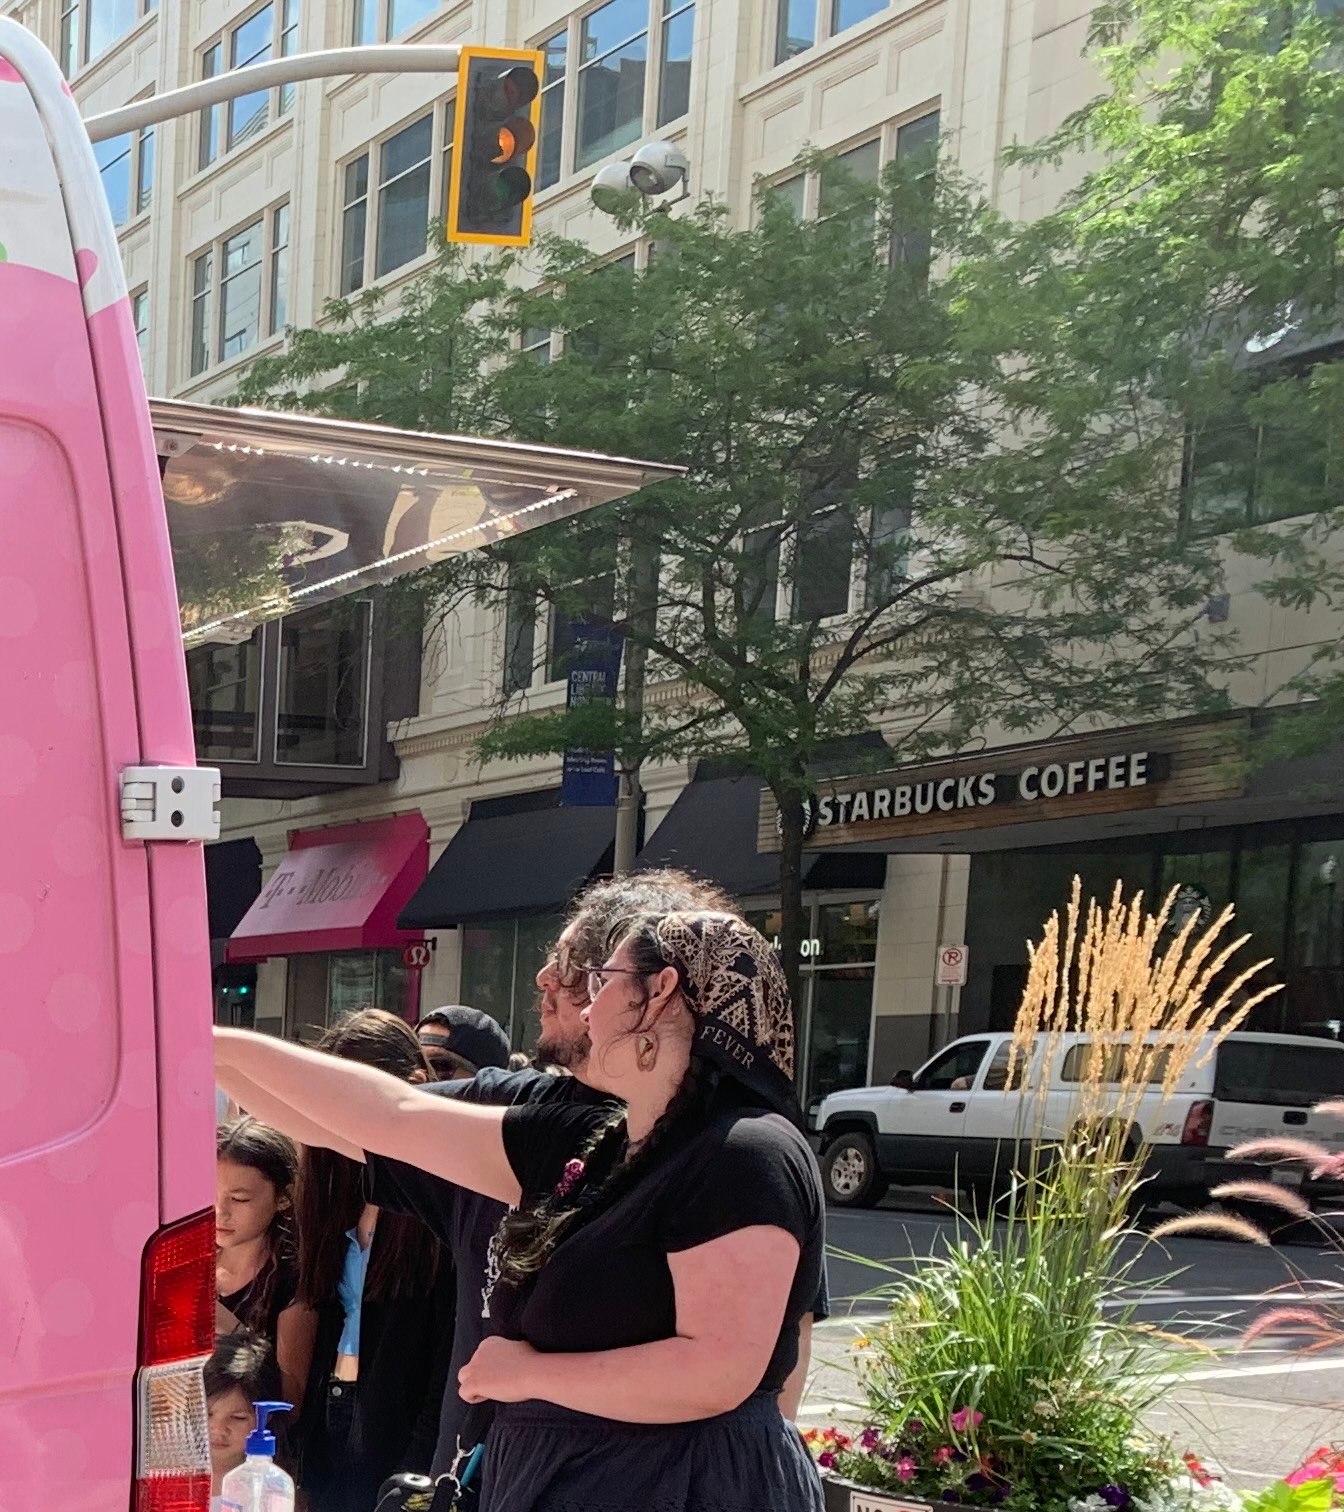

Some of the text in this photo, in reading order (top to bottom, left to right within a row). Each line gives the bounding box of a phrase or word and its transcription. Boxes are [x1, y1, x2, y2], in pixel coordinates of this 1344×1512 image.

[817, 752, 1148, 827] STARBUCKS COFFEE
[700, 1025, 755, 1070] FEVER
